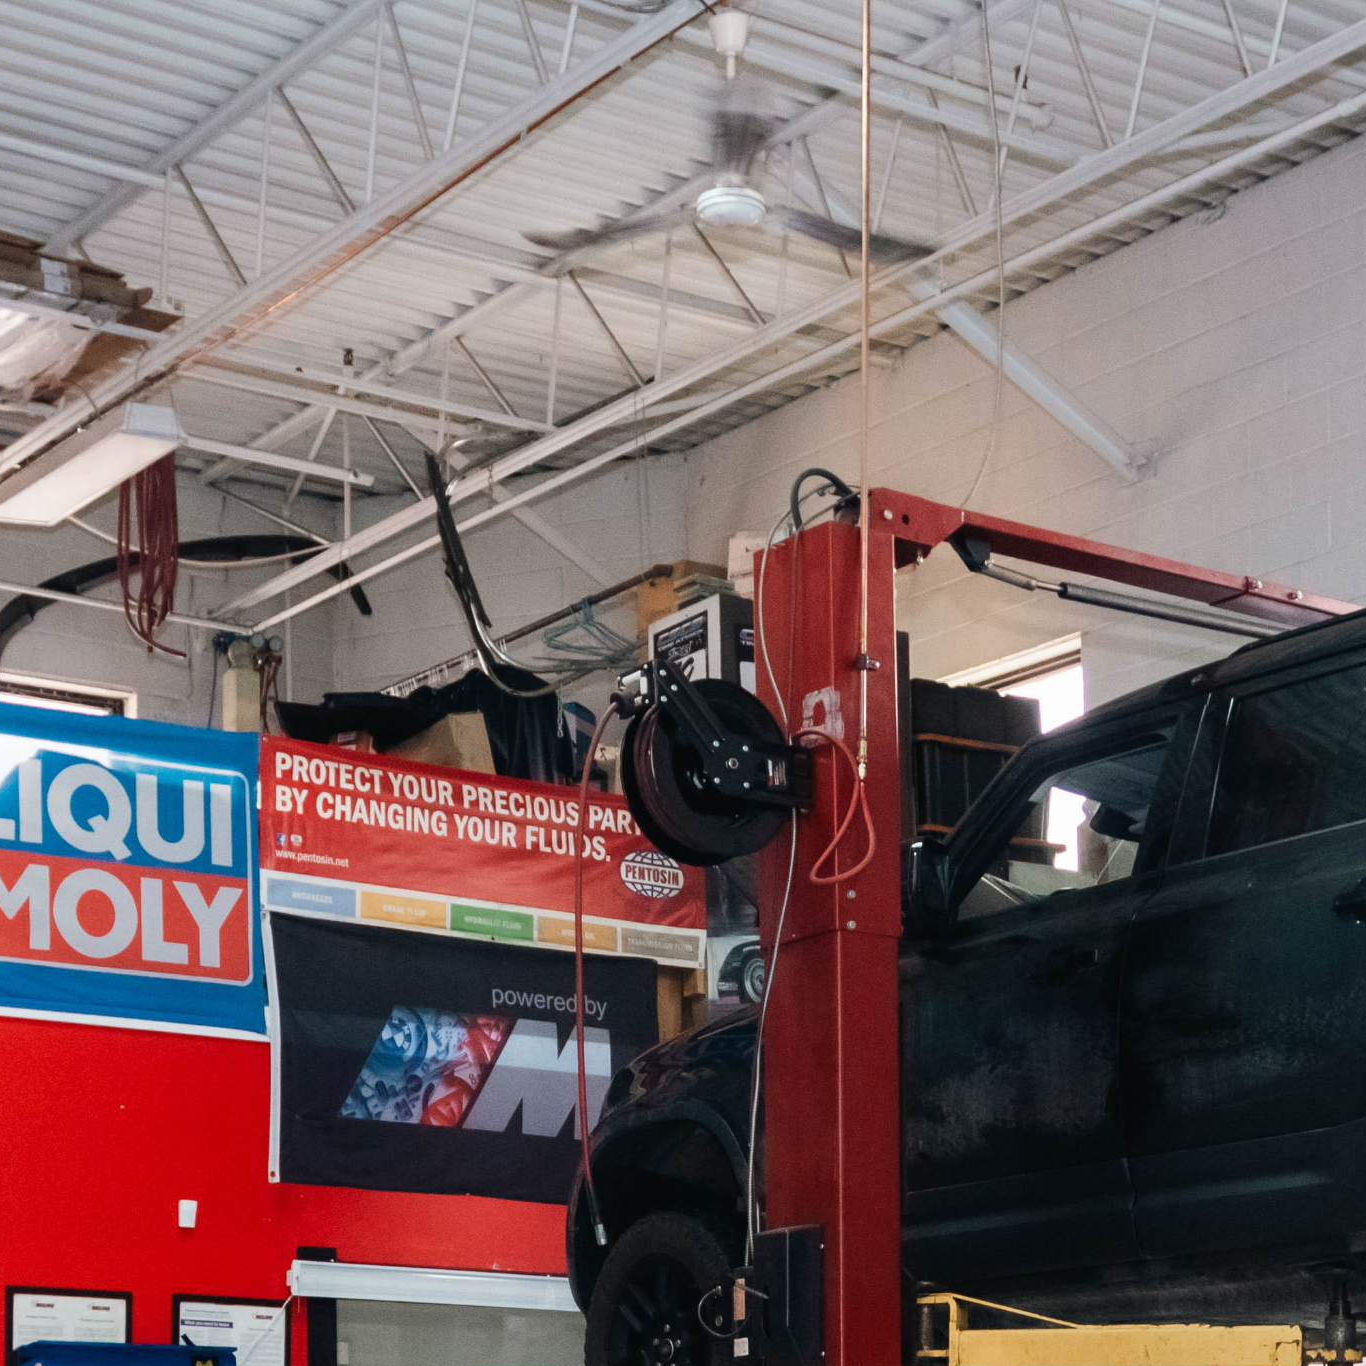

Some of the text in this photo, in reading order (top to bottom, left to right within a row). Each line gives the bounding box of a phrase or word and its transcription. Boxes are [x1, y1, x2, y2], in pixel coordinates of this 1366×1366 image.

[275, 751, 383, 795] PROTECT
[388, 771, 455, 806] YOUR
[462, 783, 580, 827] PRECIOUS
[275, 785, 309, 815] BY
[316, 791, 448, 837] CHANGING
[453, 813, 517, 848] YOUR
[275, 848, 350, 868] www.pentosin.net
[625, 863, 680, 886] PENTOSIN
[492, 988, 608, 1022] powered by
